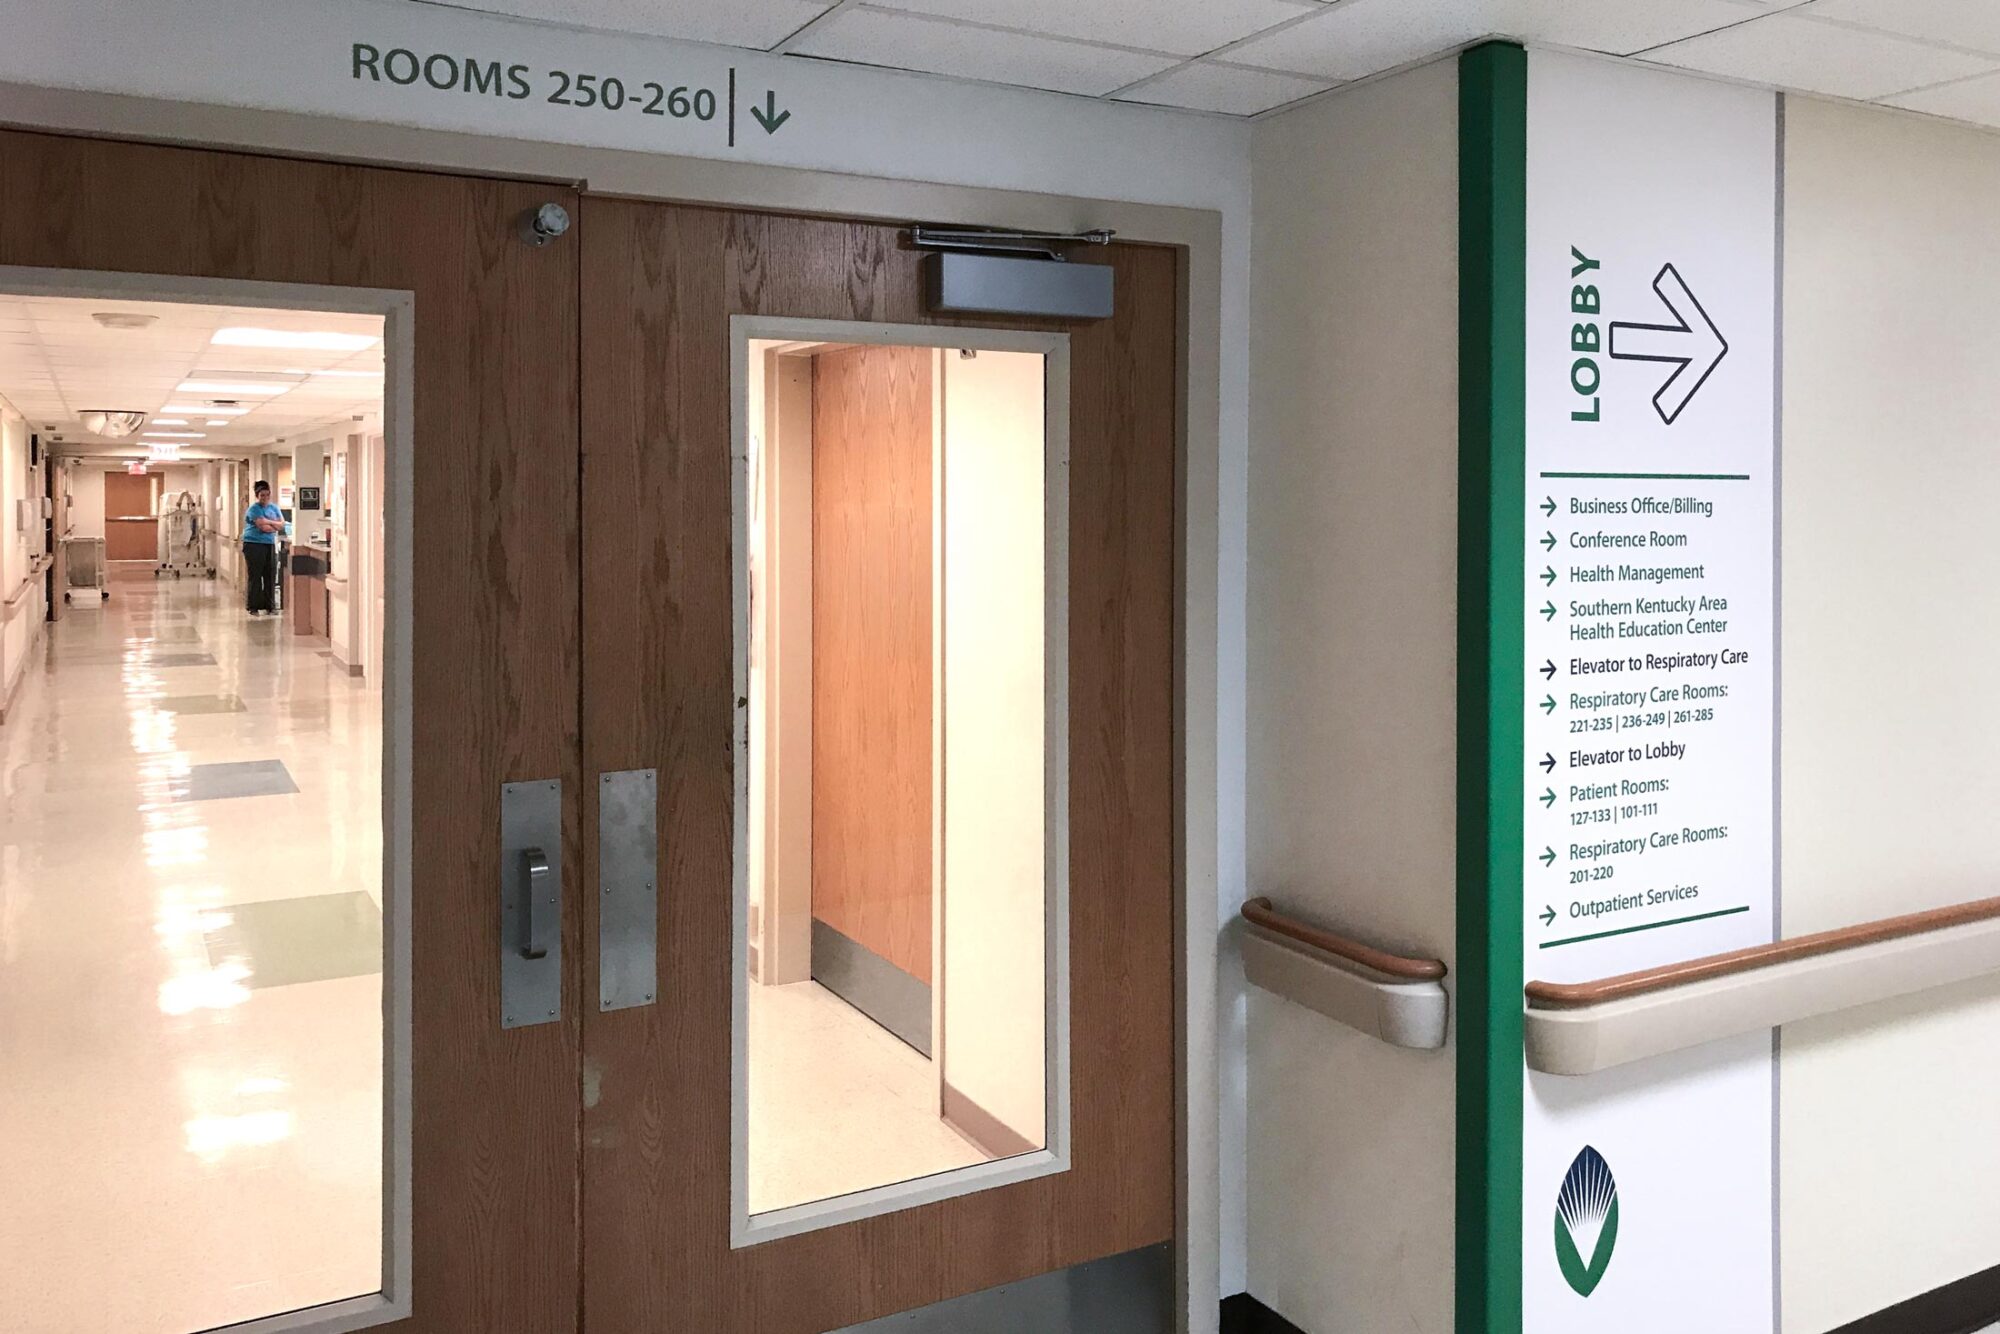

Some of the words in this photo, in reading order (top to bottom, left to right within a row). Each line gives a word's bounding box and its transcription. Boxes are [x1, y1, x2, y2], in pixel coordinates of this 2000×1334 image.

[351, 43, 532, 100] ROOMS
[547, 70, 717, 121] 250-260
[1570, 244, 1600, 422] LOBBY
[1570, 497, 1628, 514] Business
[1631, 497, 1713, 517] Office/Billing
[1570, 531, 1646, 548] Conference
[1650, 531, 1687, 547] Room
[1570, 565, 1614, 582] Health
[1618, 564, 1704, 584] Management
[1570, 598, 1632, 617] Southern
[1636, 596, 1695, 614] Kentucky
[1699, 595, 1727, 611] Area
[1570, 623, 1614, 640] Health
[1619, 621, 1683, 637] Education
[1686, 619, 1727, 635] Center
[1570, 657, 1625, 675] Elevator
[1628, 656, 1642, 671] to
[1646, 651, 1718, 672] Respiratory
[1721, 649, 1748, 665] Care
[1570, 690, 1646, 711] Respiratory
[1650, 686, 1679, 703] Care
[1682, 684, 1728, 700] Rooms:
[1570, 717, 1613, 733] 221-235
[1622, 713, 1665, 728] 236-249
[1674, 708, 1713, 724] 261-285
[1570, 749, 1625, 768] Elevator
[1628, 747, 1642, 762] to
[1646, 741, 1686, 759] Lobby
[1570, 783, 1617, 802] Patient
[1621, 777, 1669, 796] Rooms:
[1570, 809, 1611, 826] 127-133
[1620, 803, 1658, 819] 101-111
[1570, 835, 1646, 861] Respiratory
[1650, 832, 1679, 850] Care
[1682, 826, 1728, 845] Rooms:
[1570, 866, 1614, 884] 201-220
[1570, 892, 1643, 918] Outpatient
[1647, 884, 1699, 905] Services
